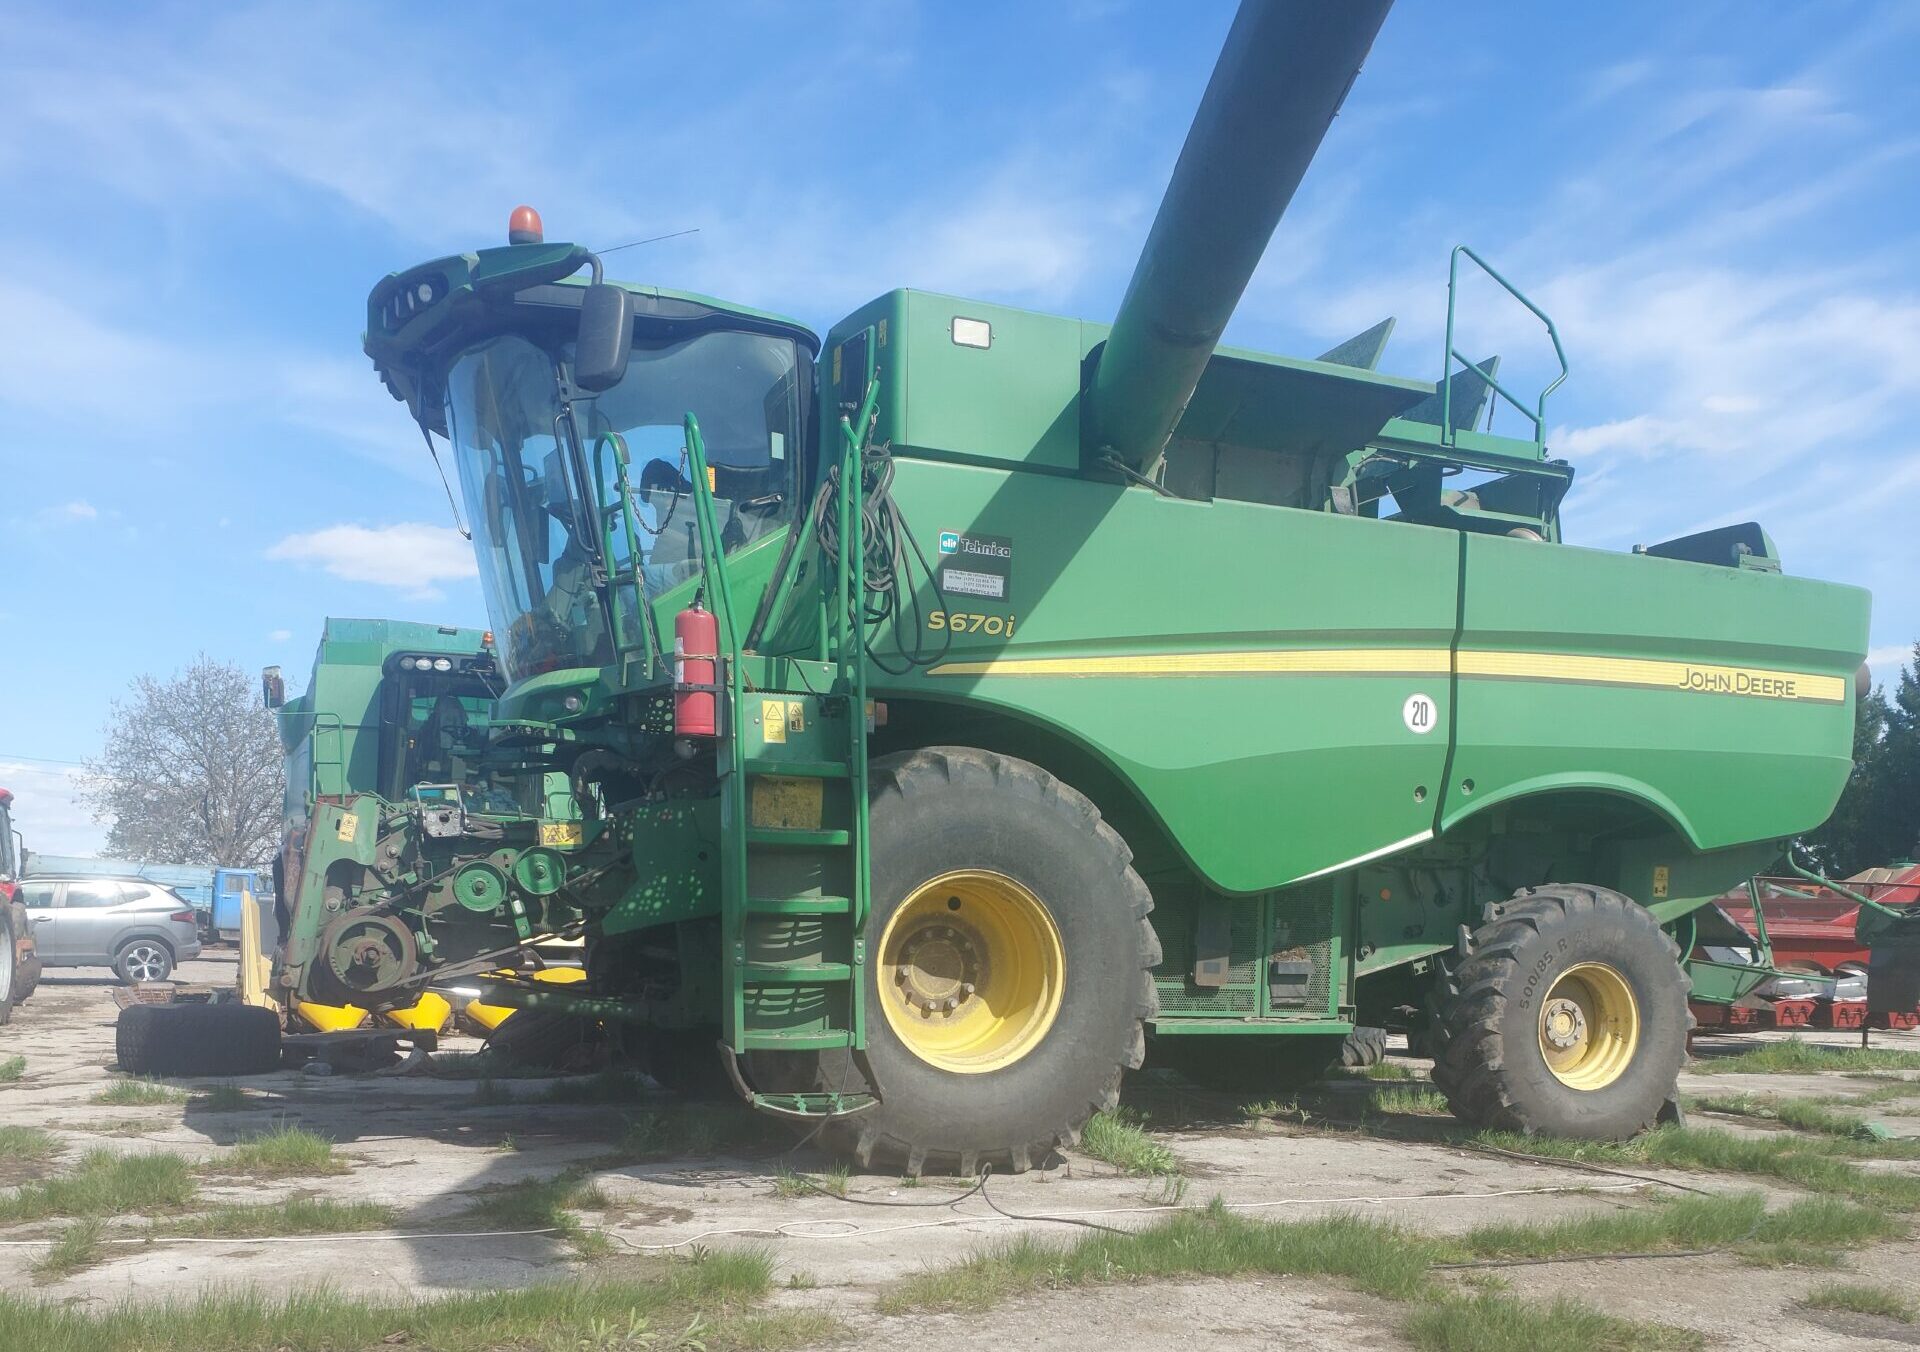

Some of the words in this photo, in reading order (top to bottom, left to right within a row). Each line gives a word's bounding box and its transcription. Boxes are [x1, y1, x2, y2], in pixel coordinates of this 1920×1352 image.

[961, 538, 1011, 557] Tehnica
[927, 611, 1014, 637] S670i
[1679, 667, 1731, 691] JOHN
[1736, 672, 1796, 696] DEERE
[1412, 700, 1428, 726] 20
[1519, 950, 1553, 1010] 500/85
[1557, 938, 1568, 952] R
